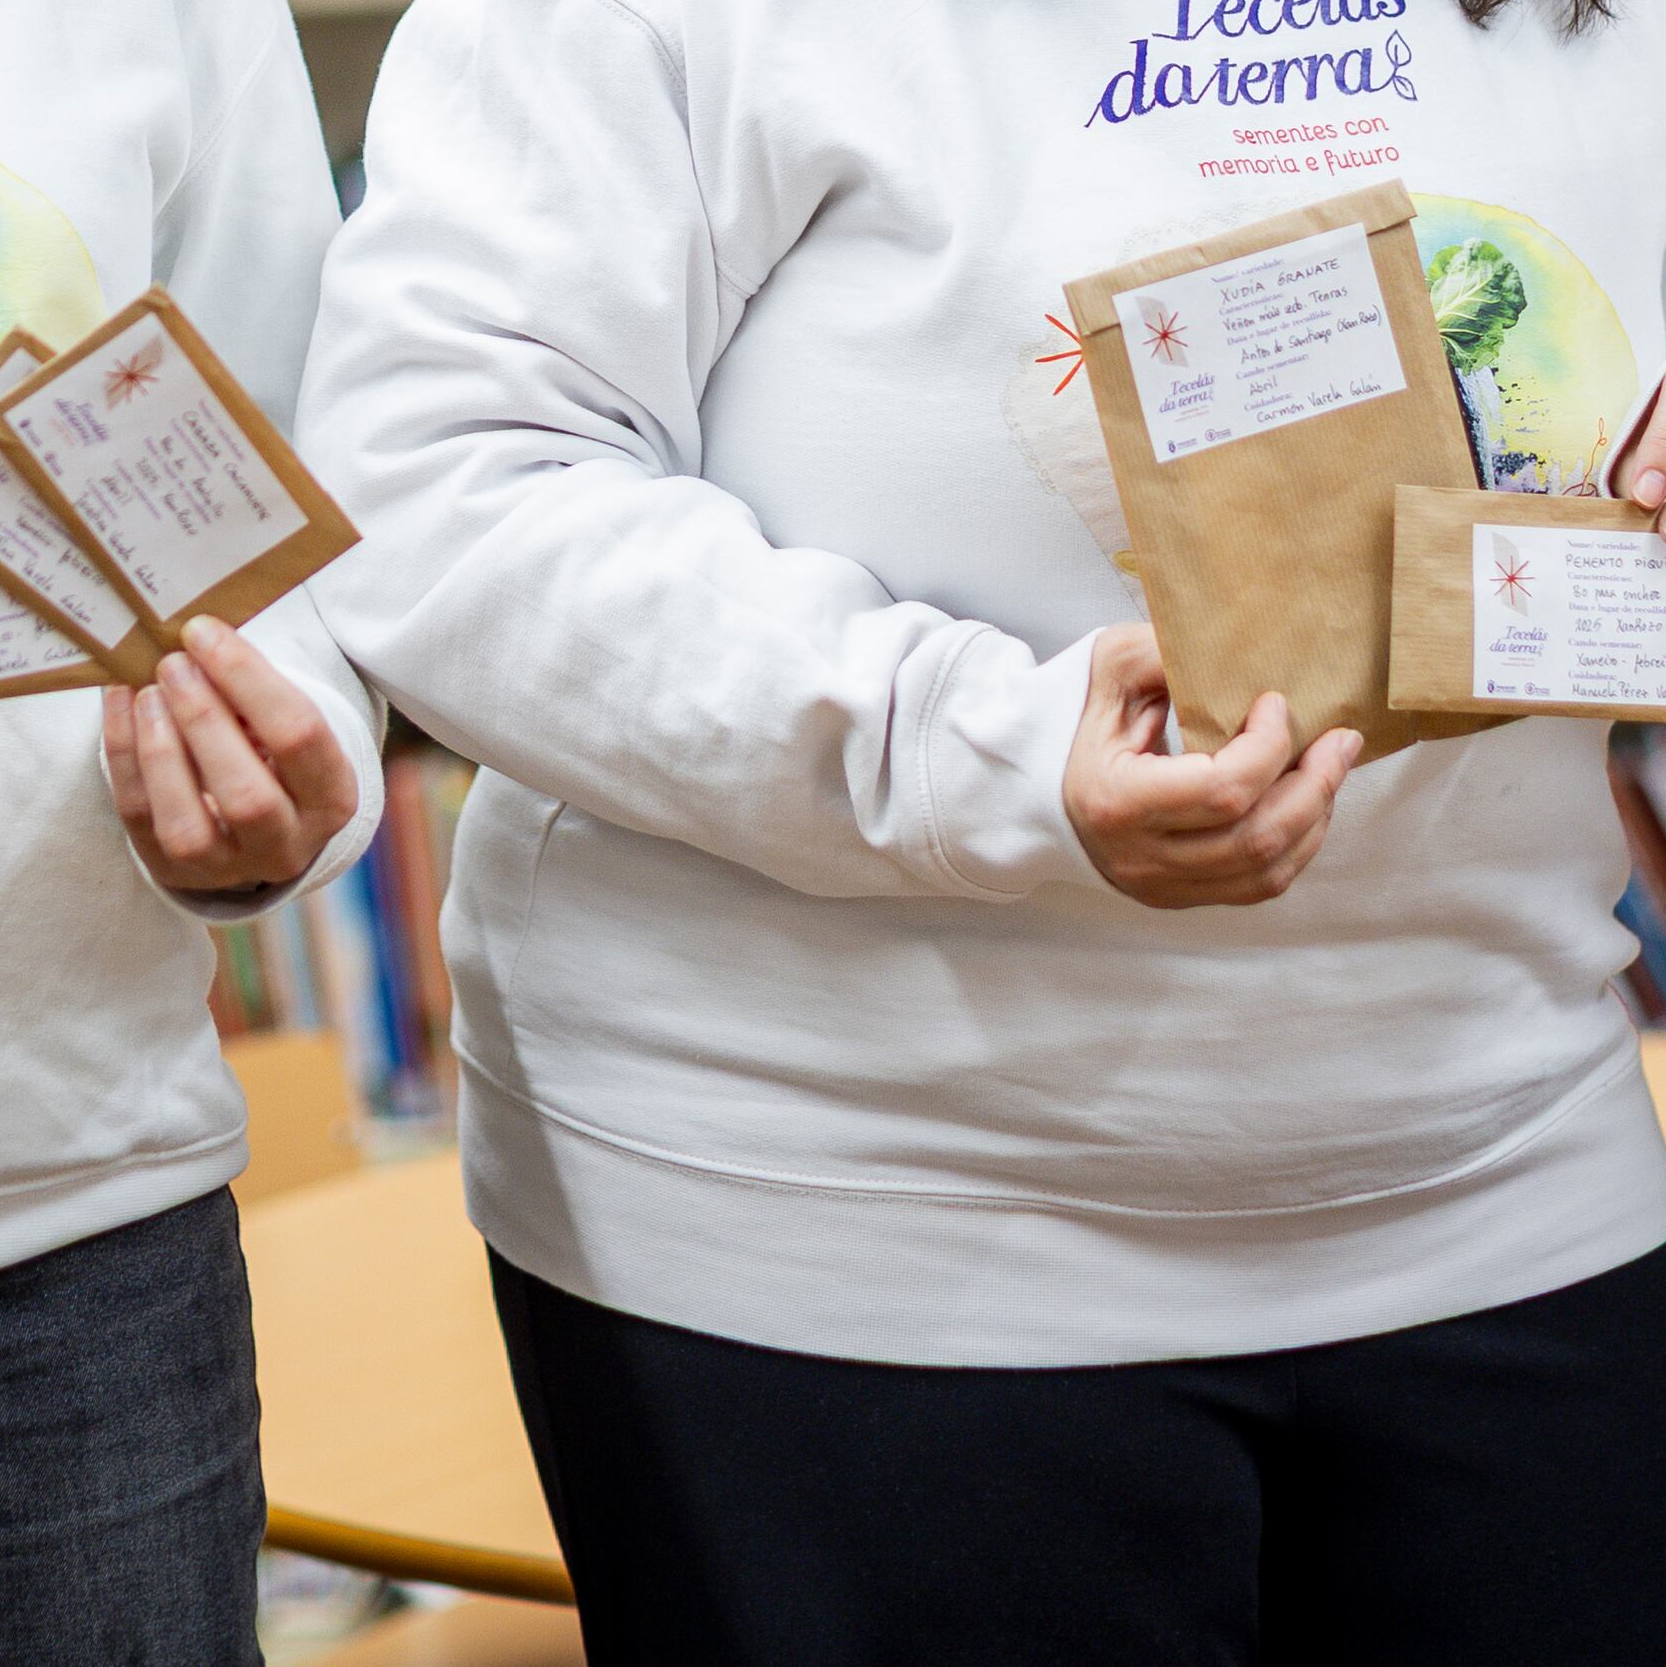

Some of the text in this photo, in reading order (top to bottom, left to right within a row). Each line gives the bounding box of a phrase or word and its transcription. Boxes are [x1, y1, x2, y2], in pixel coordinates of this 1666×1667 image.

[1232, 113, 1390, 147] sementes con
[1198, 145, 1401, 179] memoria e futuro
[1277, 257, 1340, 287] GRANATE
[1288, 328, 1332, 349] Santiago
[1170, 372, 1215, 396] Tecelás
[1235, 366, 1266, 381] Cando
[1249, 374, 1278, 397] Abril
[1565, 553, 1624, 569] PEMENTO
[1505, 625, 1549, 642] Tecelás
[1567, 637, 1598, 648] Cando
